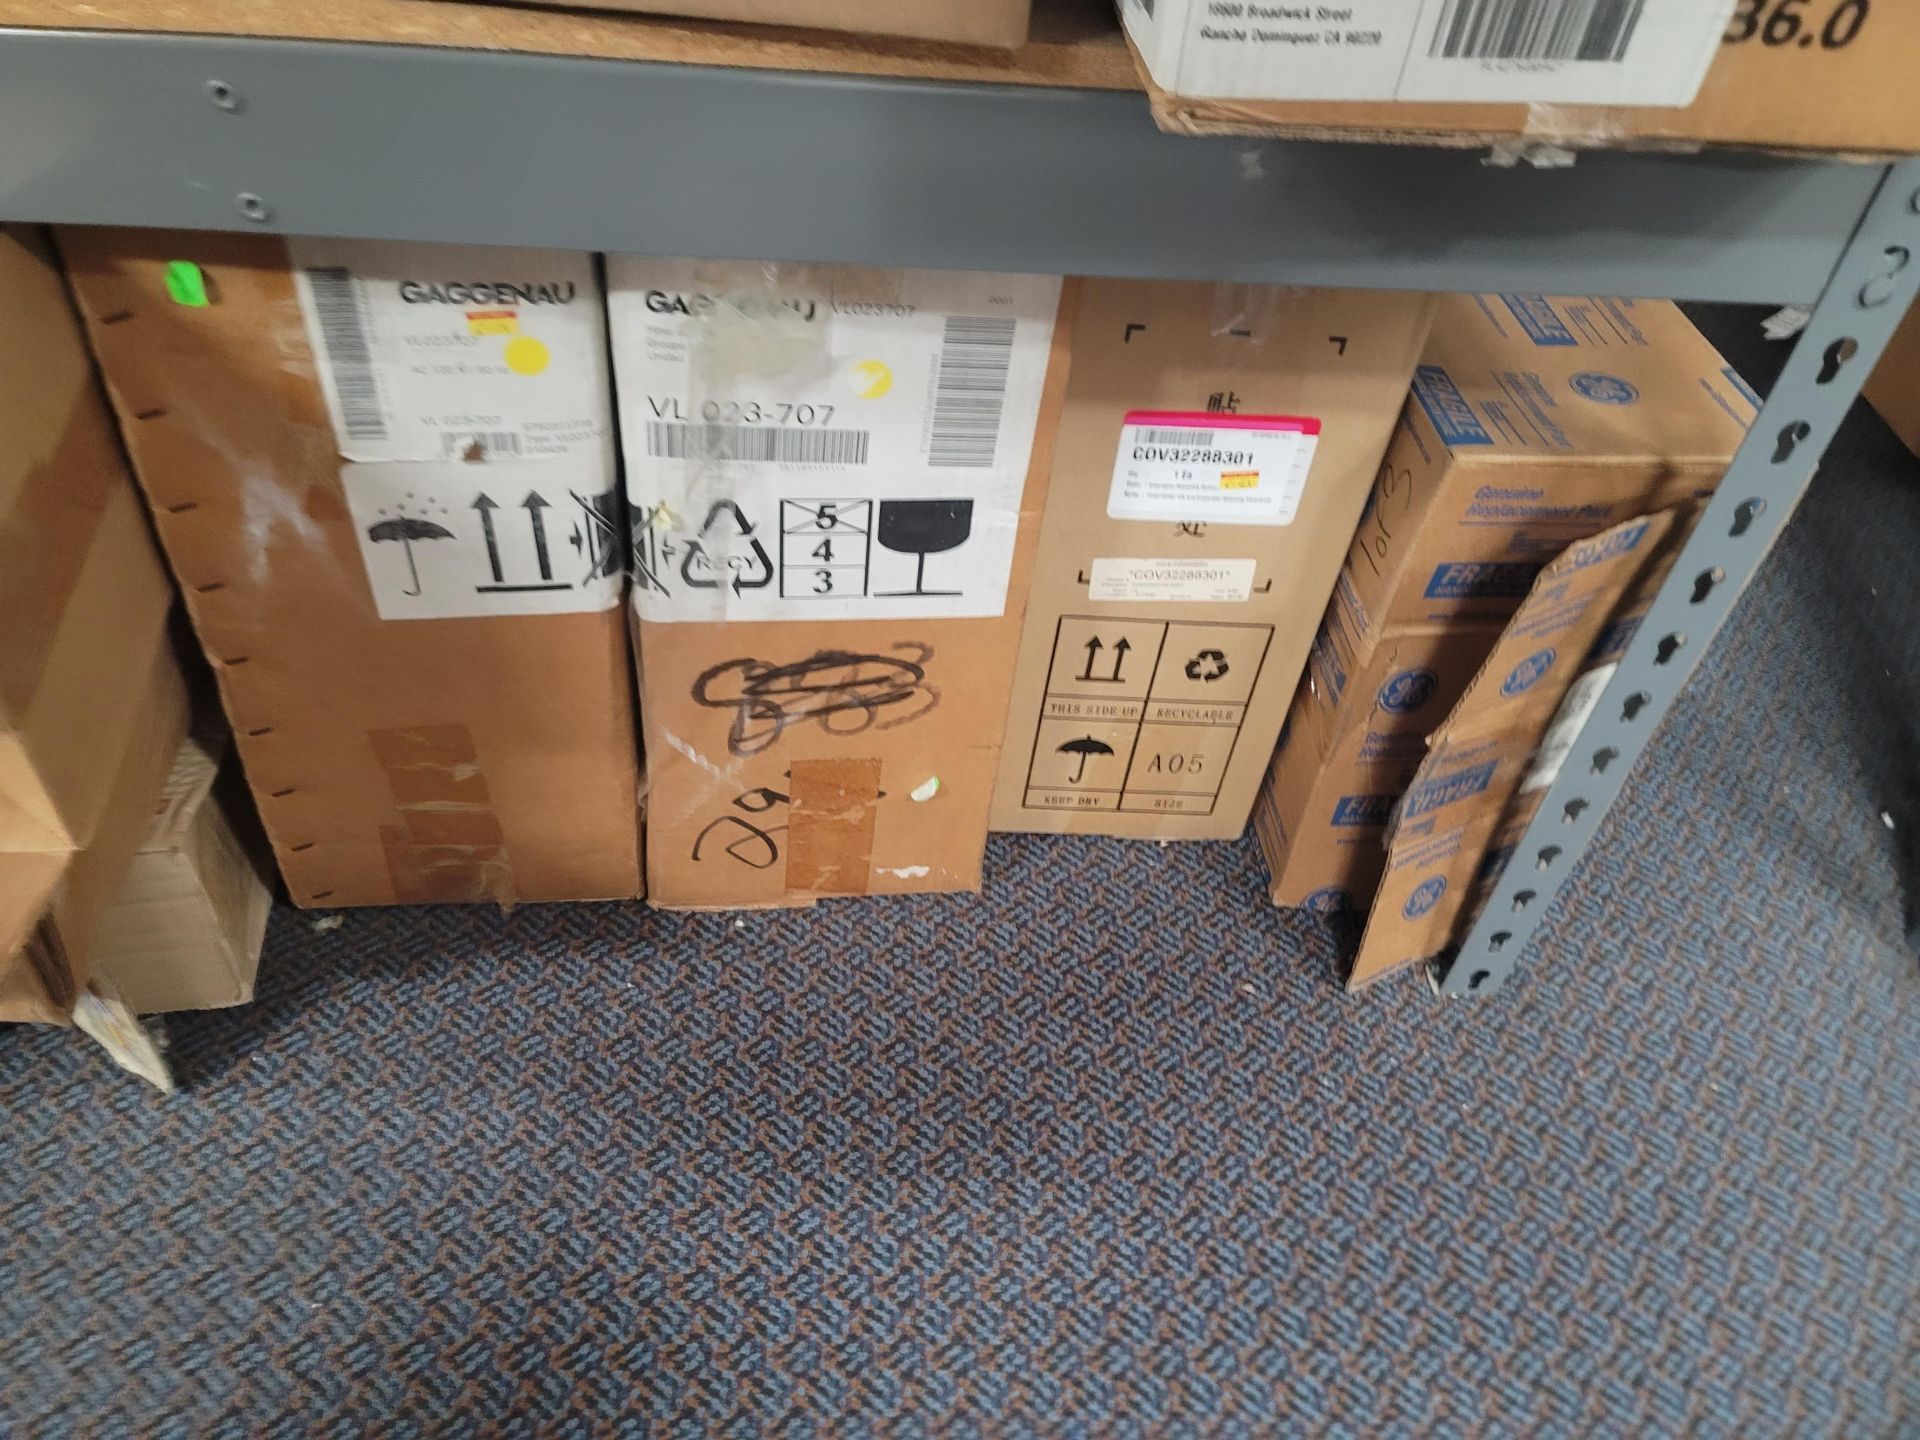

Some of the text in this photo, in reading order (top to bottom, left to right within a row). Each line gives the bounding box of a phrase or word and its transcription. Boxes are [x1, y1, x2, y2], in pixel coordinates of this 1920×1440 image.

[400, 281, 576, 306] GAGGENAU
[647, 396, 836, 426] VL 023-707
[815, 504, 840, 530] 5
[811, 538, 835, 562] 4
[812, 570, 835, 594] 3
[1050, 703, 1139, 717] THIS SIDE UP
[1156, 707, 1234, 721] RECYCLABLE
[1147, 753, 1205, 775] A05
[1077, 796, 1101, 807] DRY
